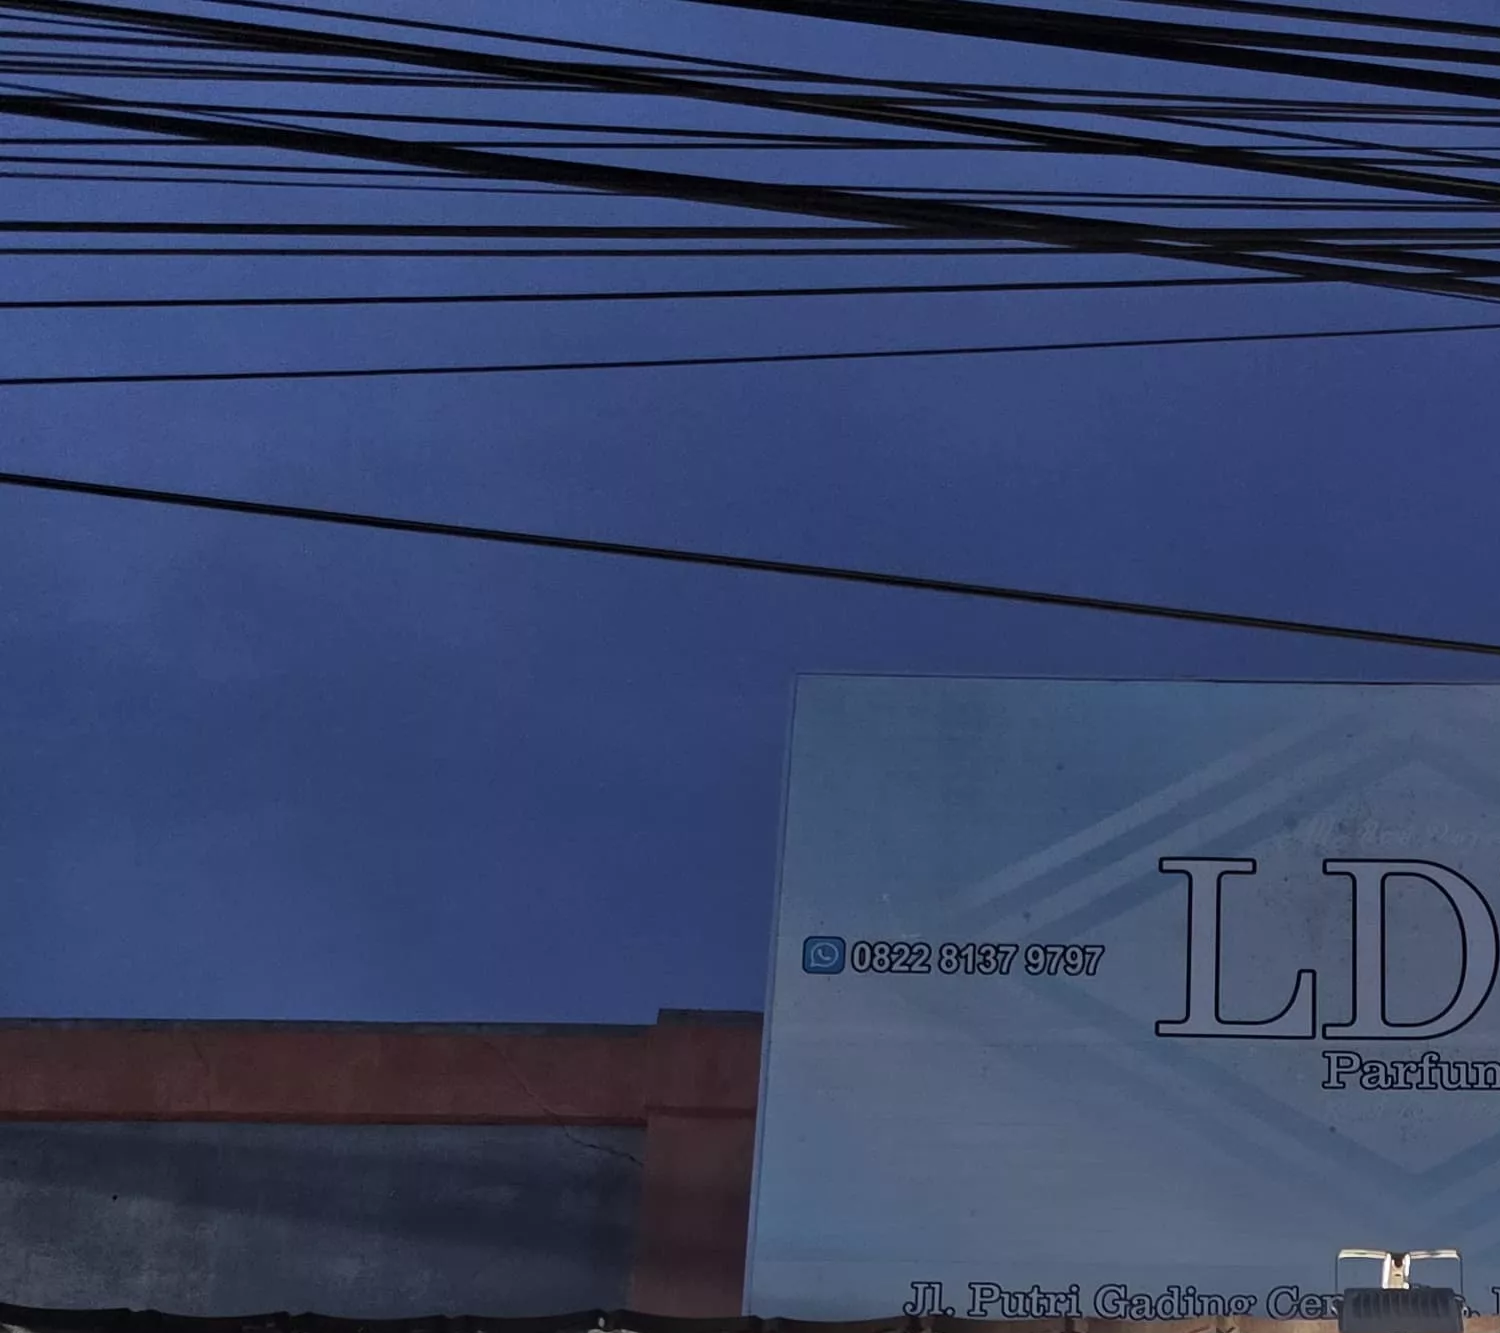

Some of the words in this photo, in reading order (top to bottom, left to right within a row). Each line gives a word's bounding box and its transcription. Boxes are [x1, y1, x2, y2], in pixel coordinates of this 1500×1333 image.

[852, 941, 931, 973] 0822
[938, 943, 1018, 974] 8137
[1025, 945, 1104, 976] 9797
[902, 1281, 955, 1317] Jl.
[967, 1282, 1081, 1318] Putri
[1094, 1283, 1257, 1320] Gading
